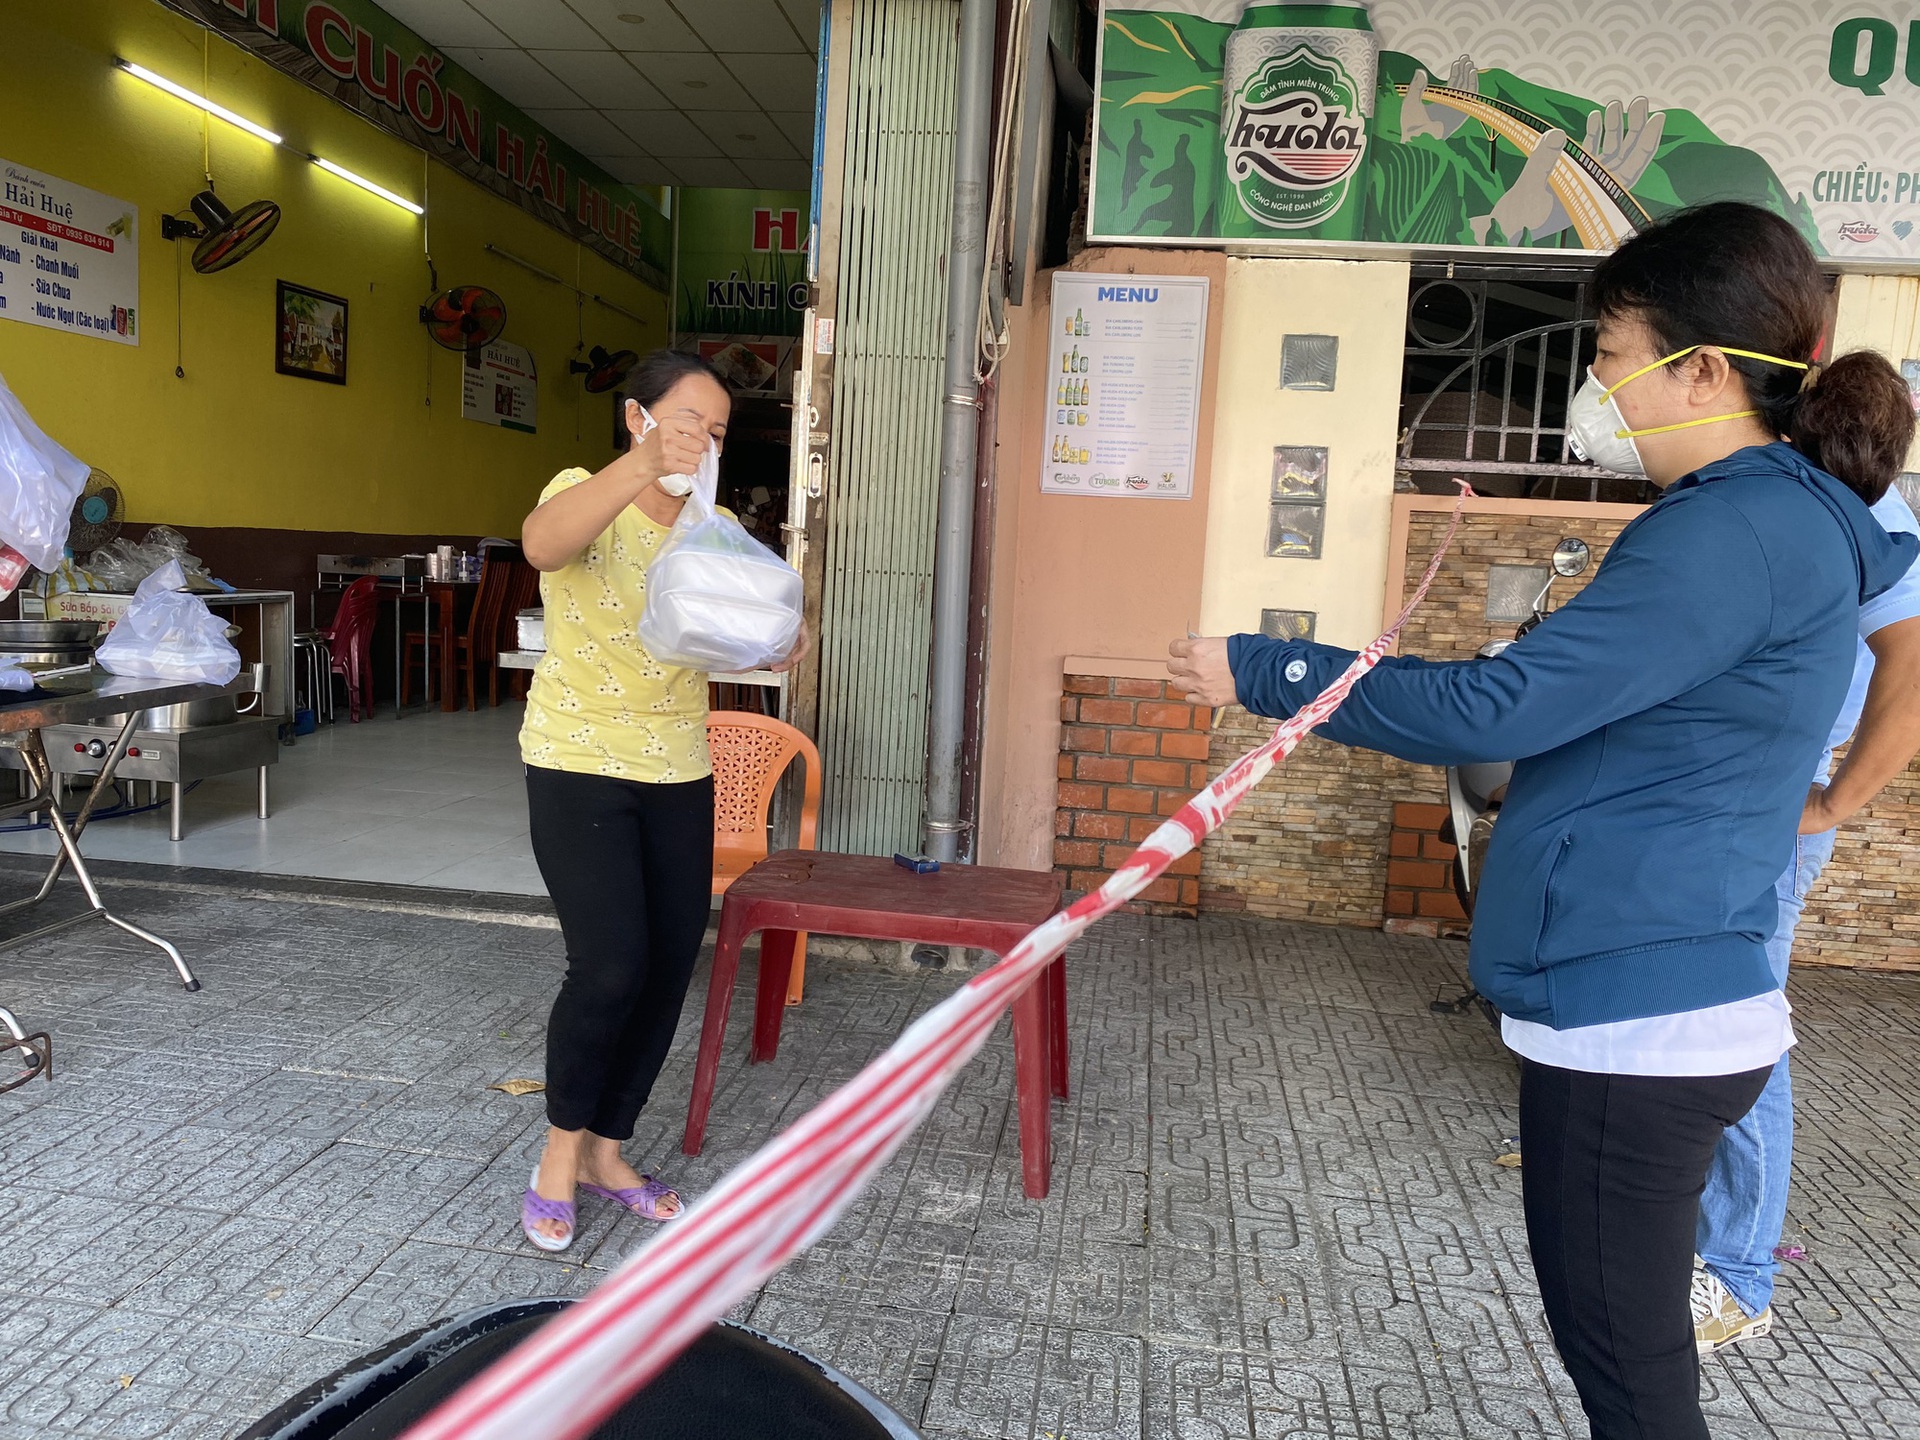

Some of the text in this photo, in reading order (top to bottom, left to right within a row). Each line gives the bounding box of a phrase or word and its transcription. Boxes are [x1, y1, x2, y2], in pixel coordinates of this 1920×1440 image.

[1828, 17, 1920, 96] Q
[1277, 79, 1295, 89] TÌNH
[1297, 77, 1317, 89] MIỀN
[1318, 83, 1340, 101] TRUNG
[303, 0, 481, 163] CUỐN
[496, 121, 567, 213] HẢI
[578, 178, 642, 267] HUỆ
[1229, 98, 1362, 151] huda
[1813, 162, 1889, 203] CHIỀU:
[5, 182, 73, 224] Hải Huệ
[1250, 189, 1270, 207] CÔNG
[1270, 201, 1293, 213] NGHỆ
[1838, 221, 1880, 236] huda
[21, 230, 59, 252] Giải Khát
[36, 254, 60, 274] Chanh
[36, 278, 71, 300] Sữa Chua
[706, 271, 777, 310] KÍNH
[1097, 286, 1159, 303] MENU
[57, 306, 75, 326] Ngọt
[487, 348, 503, 362] HẢI
[1095, 477, 1120, 487] TUBORG
[60, 601, 78, 612] Sữa
